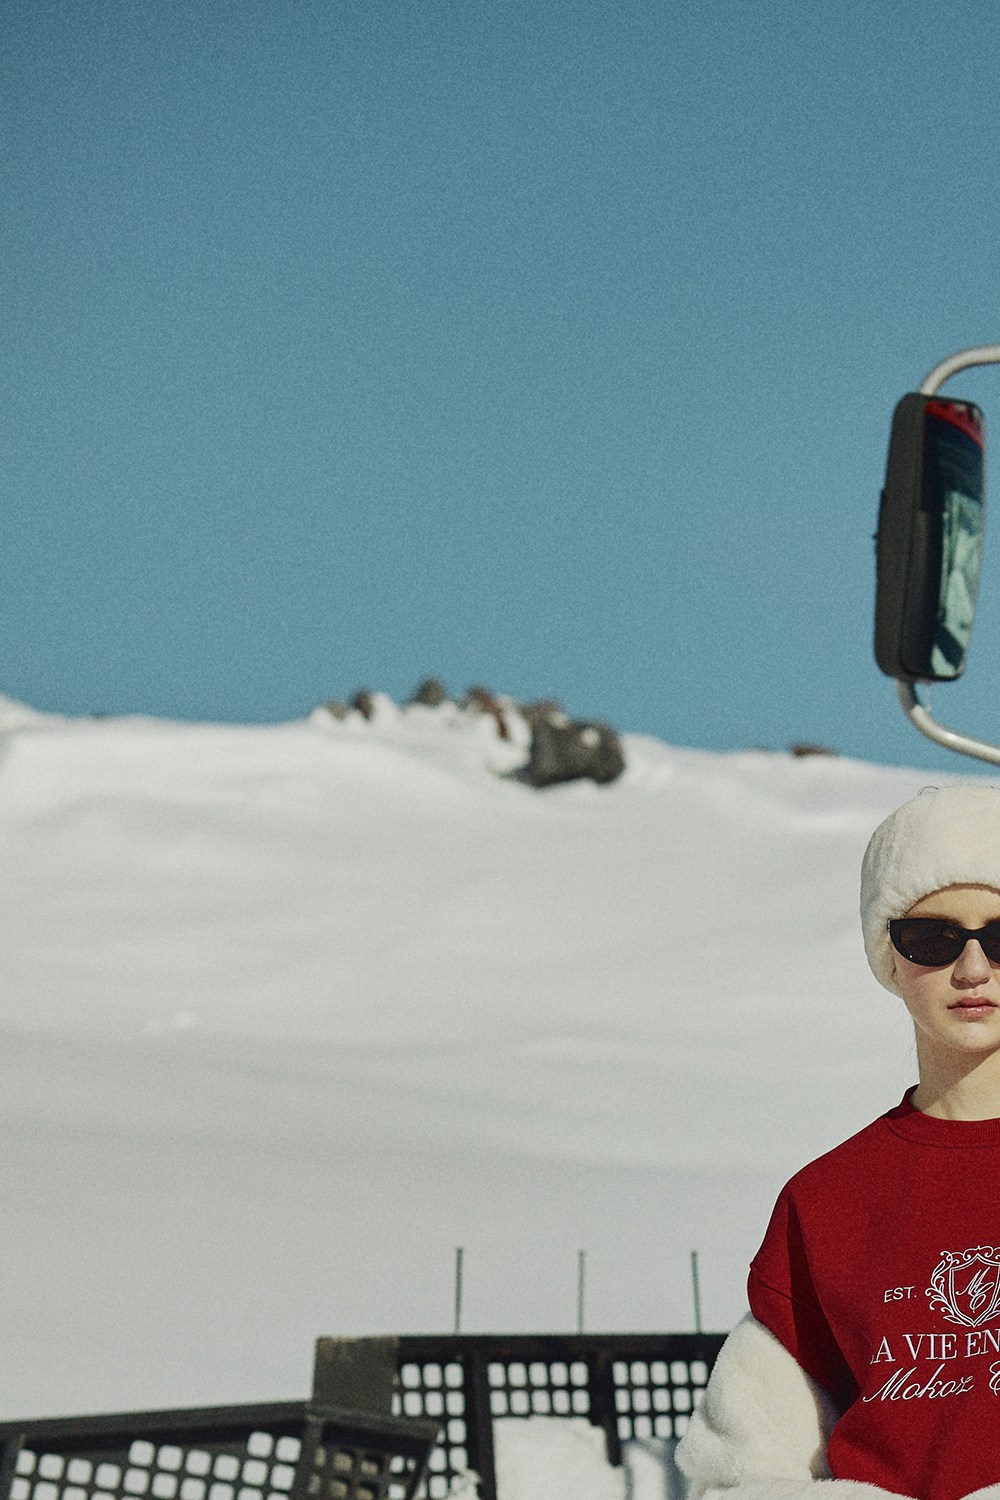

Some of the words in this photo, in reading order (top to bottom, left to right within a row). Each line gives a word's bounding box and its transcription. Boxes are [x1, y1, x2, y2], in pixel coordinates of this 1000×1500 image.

[883, 1286, 917, 1303] EST.
[870, 1336, 896, 1364] A
[902, 1333, 958, 1361] VIE
